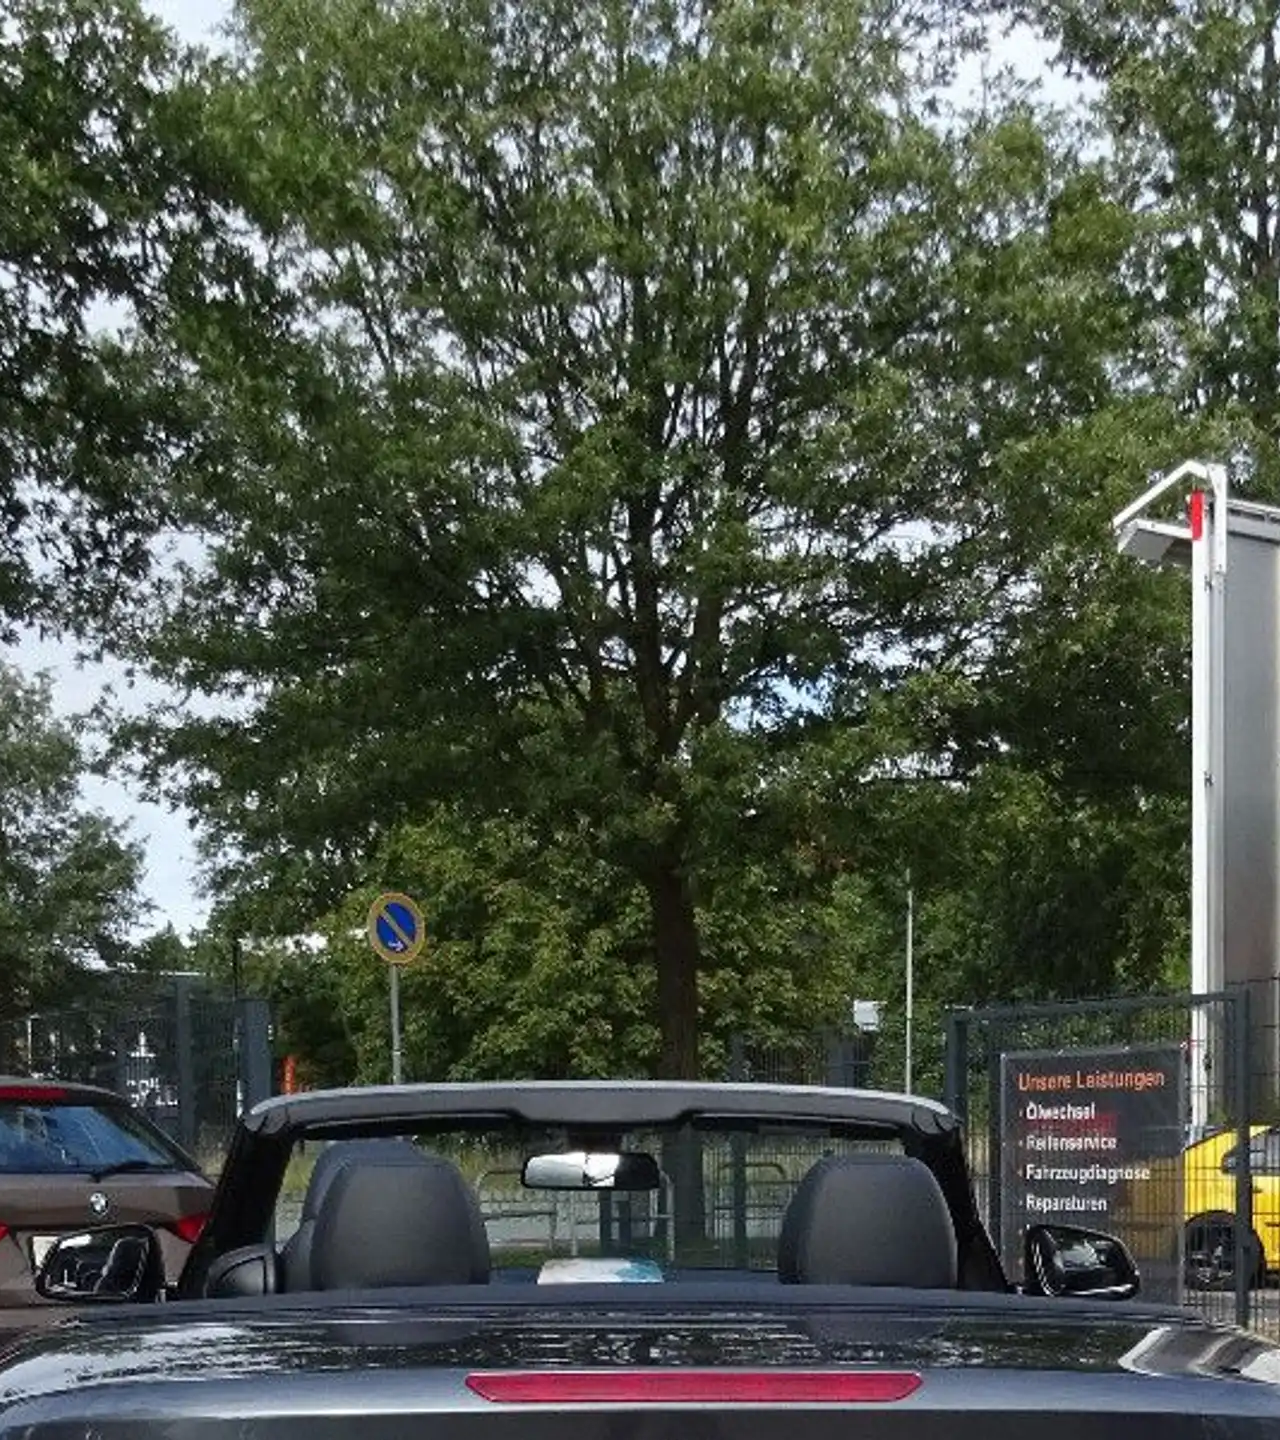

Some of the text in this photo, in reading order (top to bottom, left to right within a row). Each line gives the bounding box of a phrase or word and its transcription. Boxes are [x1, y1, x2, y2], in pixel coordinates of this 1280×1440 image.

[1019, 1070, 1165, 1091] Unsere Leistungen
[1026, 1101, 1095, 1119] Ölwechsel
[1026, 1134, 1117, 1150] Reifenservice
[1026, 1164, 1151, 1184] Fahrzeugdiagnose
[1026, 1194, 1108, 1213] Reparaturen
